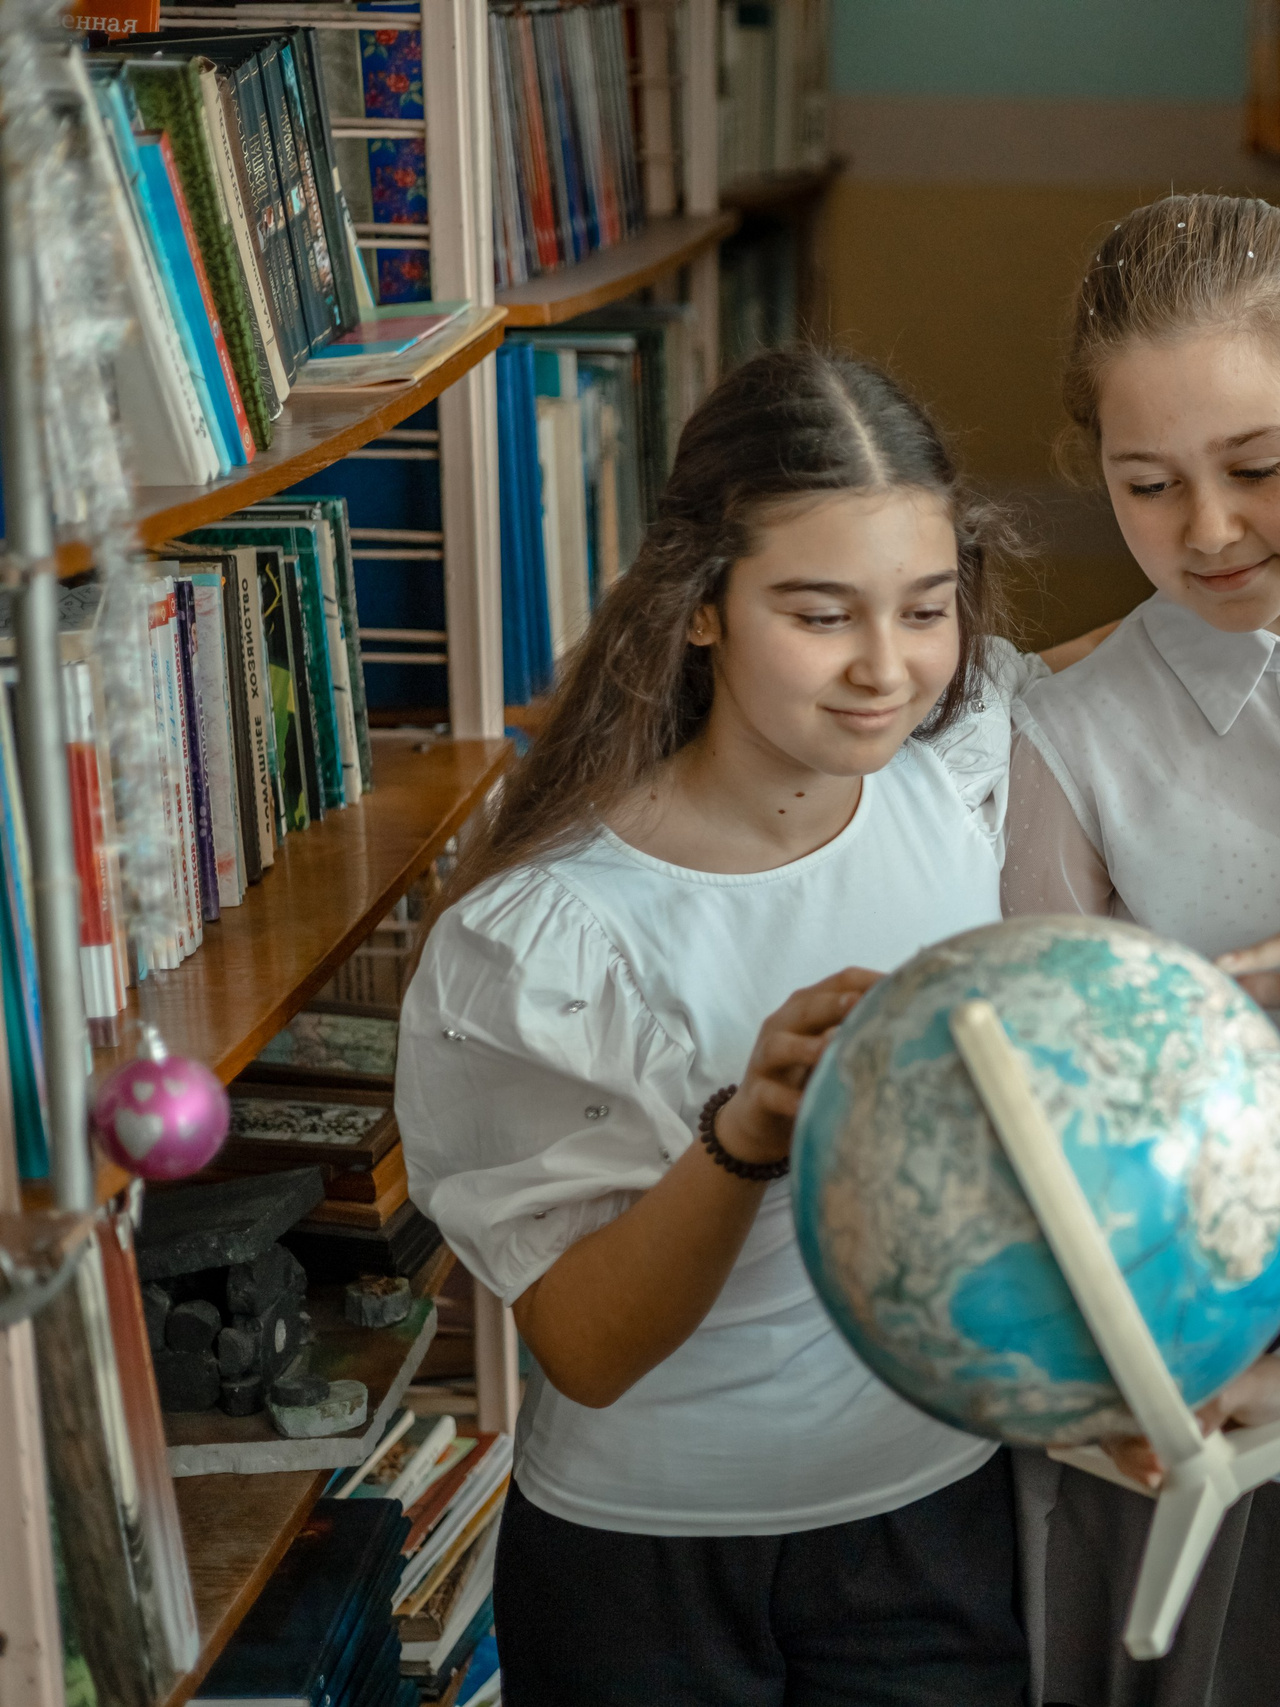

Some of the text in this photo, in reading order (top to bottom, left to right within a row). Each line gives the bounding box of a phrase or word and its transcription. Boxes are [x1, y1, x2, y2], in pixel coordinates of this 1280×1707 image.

[247, 132, 268, 201] ПУШКИН
[258, 112, 279, 191] НЕКРАСОВ
[240, 577, 259, 698] ХОЗЯЙСТВО
[174, 782, 195, 939] ХРЕСТОМАТИЯ
[189, 842, 202, 929] КУРОЛЕСОВ
